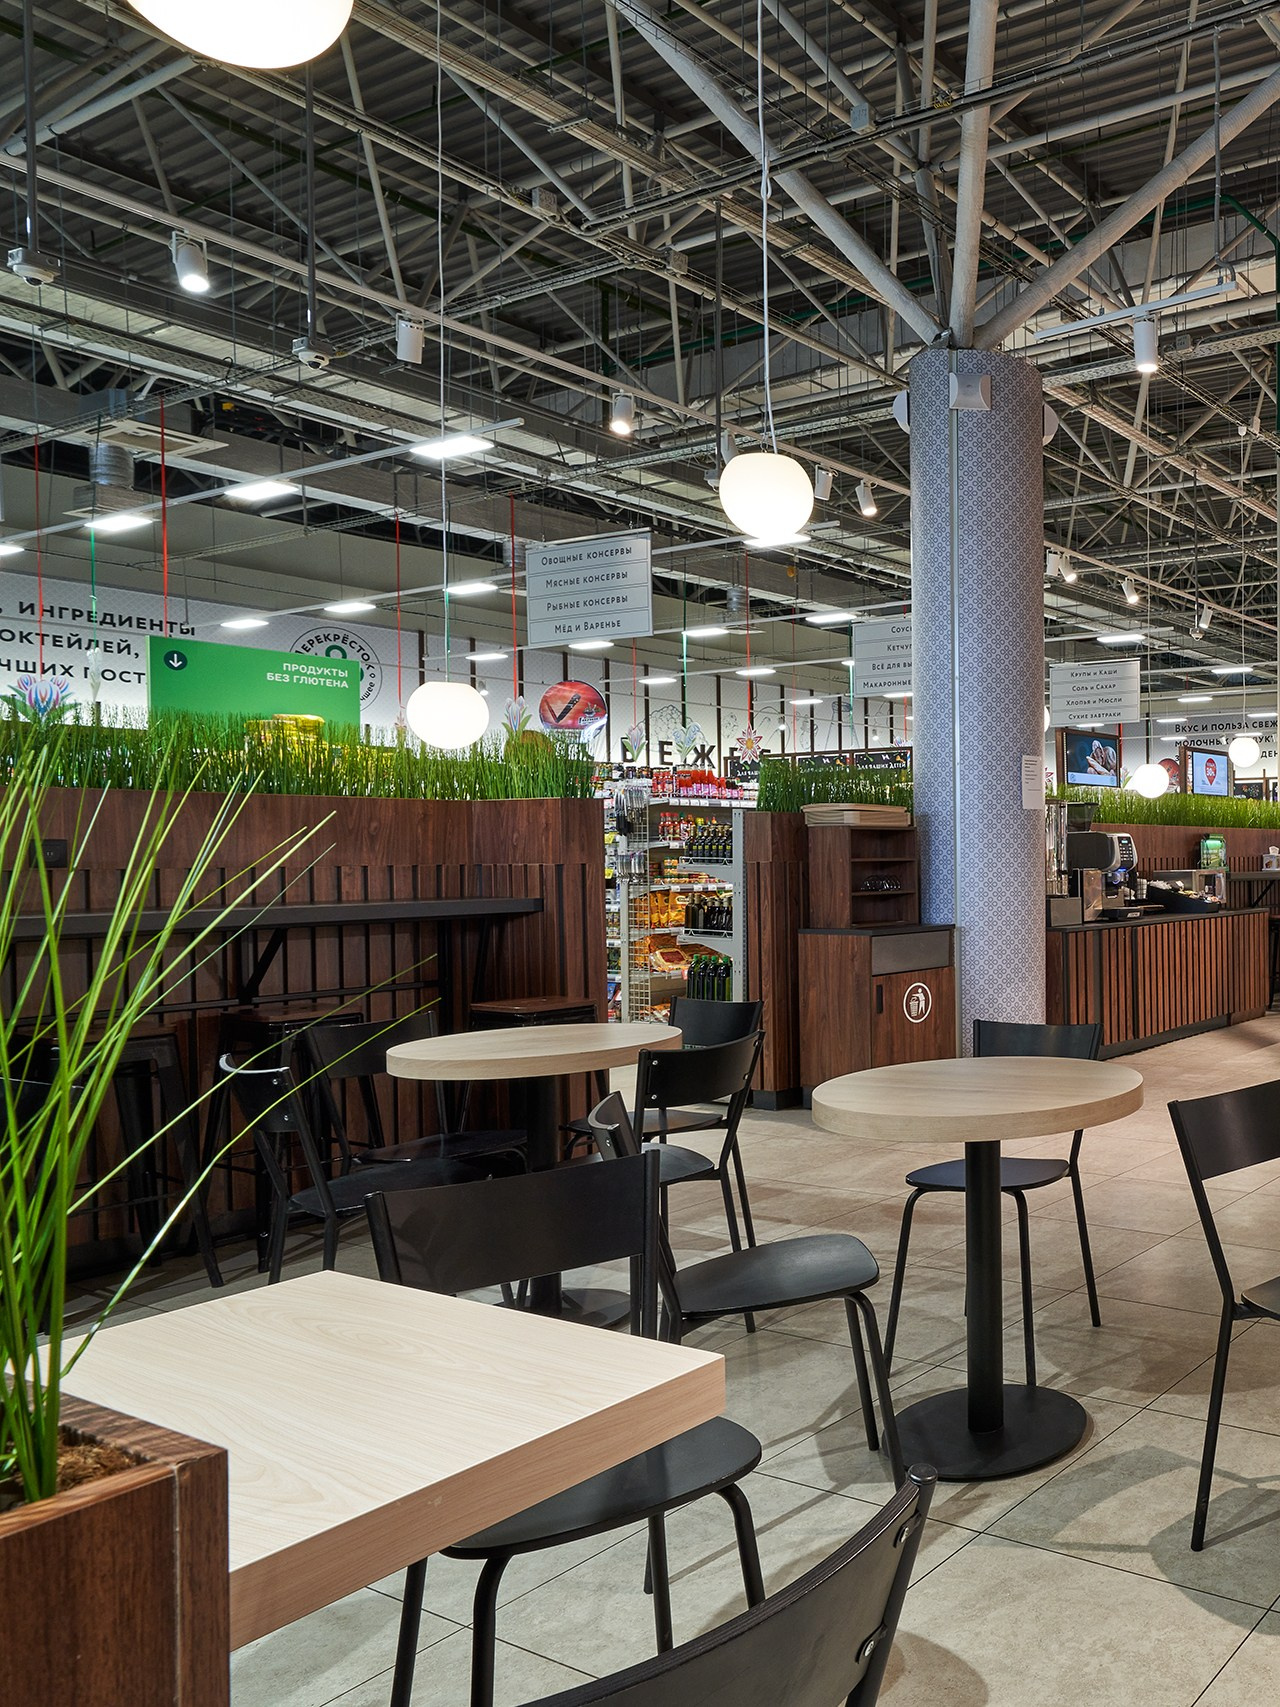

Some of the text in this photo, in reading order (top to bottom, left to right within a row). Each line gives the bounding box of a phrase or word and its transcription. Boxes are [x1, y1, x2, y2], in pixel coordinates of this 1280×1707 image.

[282, 662, 349, 678] ПРОДУКТЫ
[266, 672, 349, 689] БЕЗ ГЛЮТЕНА
[1211, 721, 1249, 731] ПОЛЬЗА
